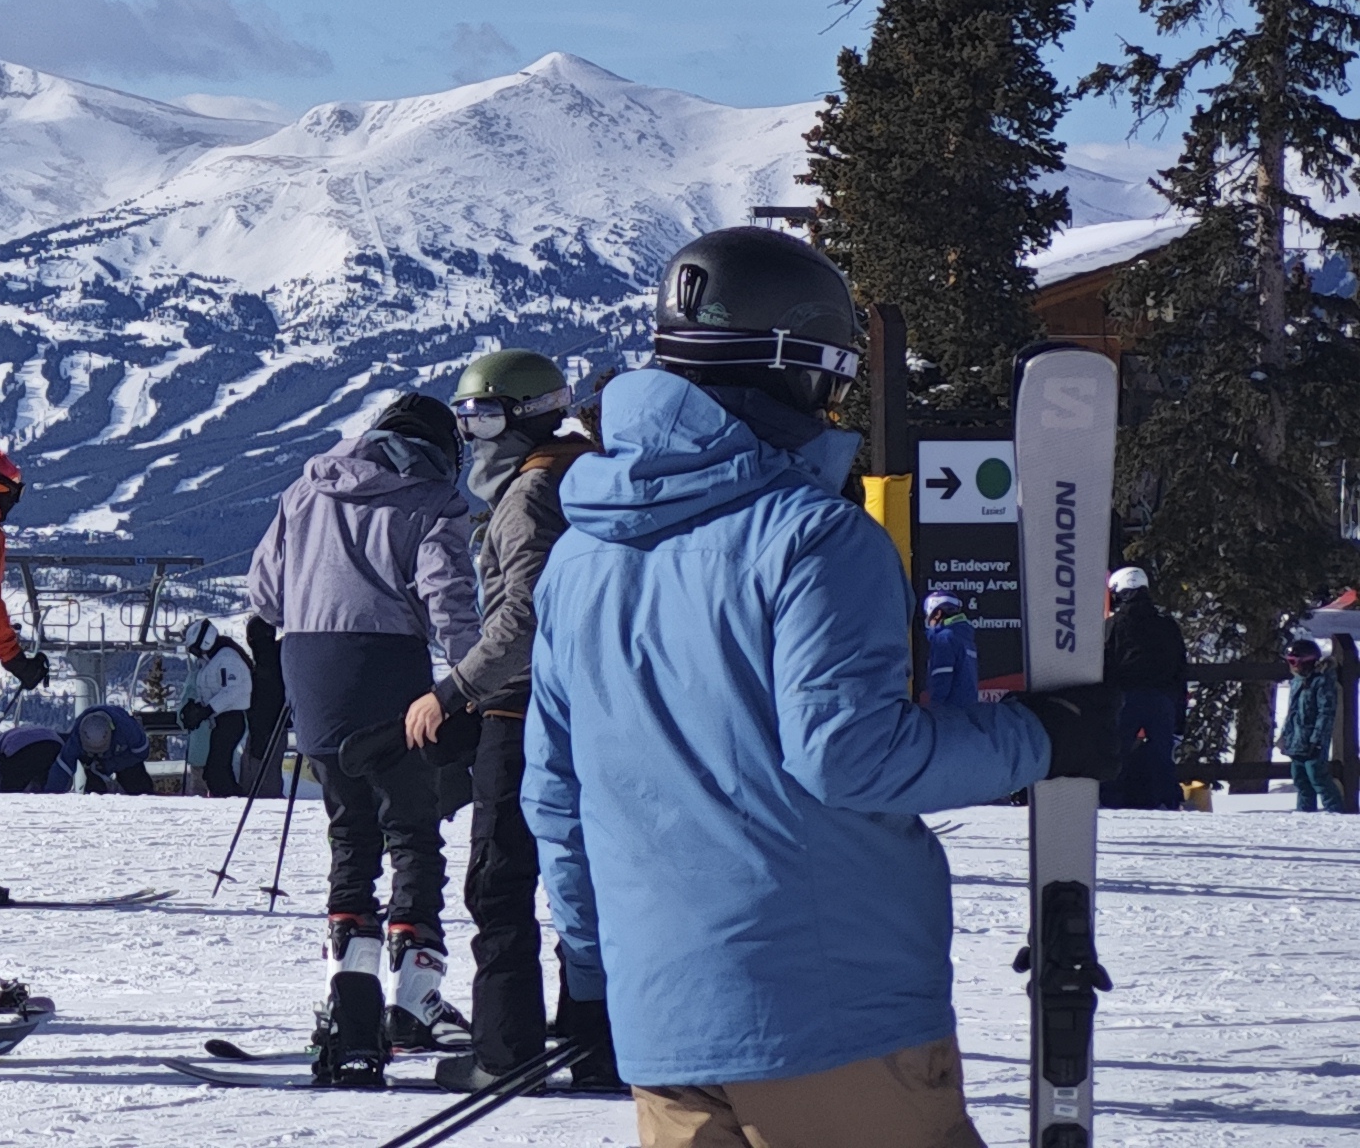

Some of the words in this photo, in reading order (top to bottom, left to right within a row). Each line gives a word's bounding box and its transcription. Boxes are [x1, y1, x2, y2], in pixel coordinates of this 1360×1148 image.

[982, 506, 1007, 516] Easiest
[934, 559, 948, 572] to
[950, 559, 1011, 572] Endeavor
[1055, 481, 1077, 653] SALOMON
[927, 578, 984, 594] Learning
[986, 578, 1018, 591] Area
[968, 597, 978, 610] &
